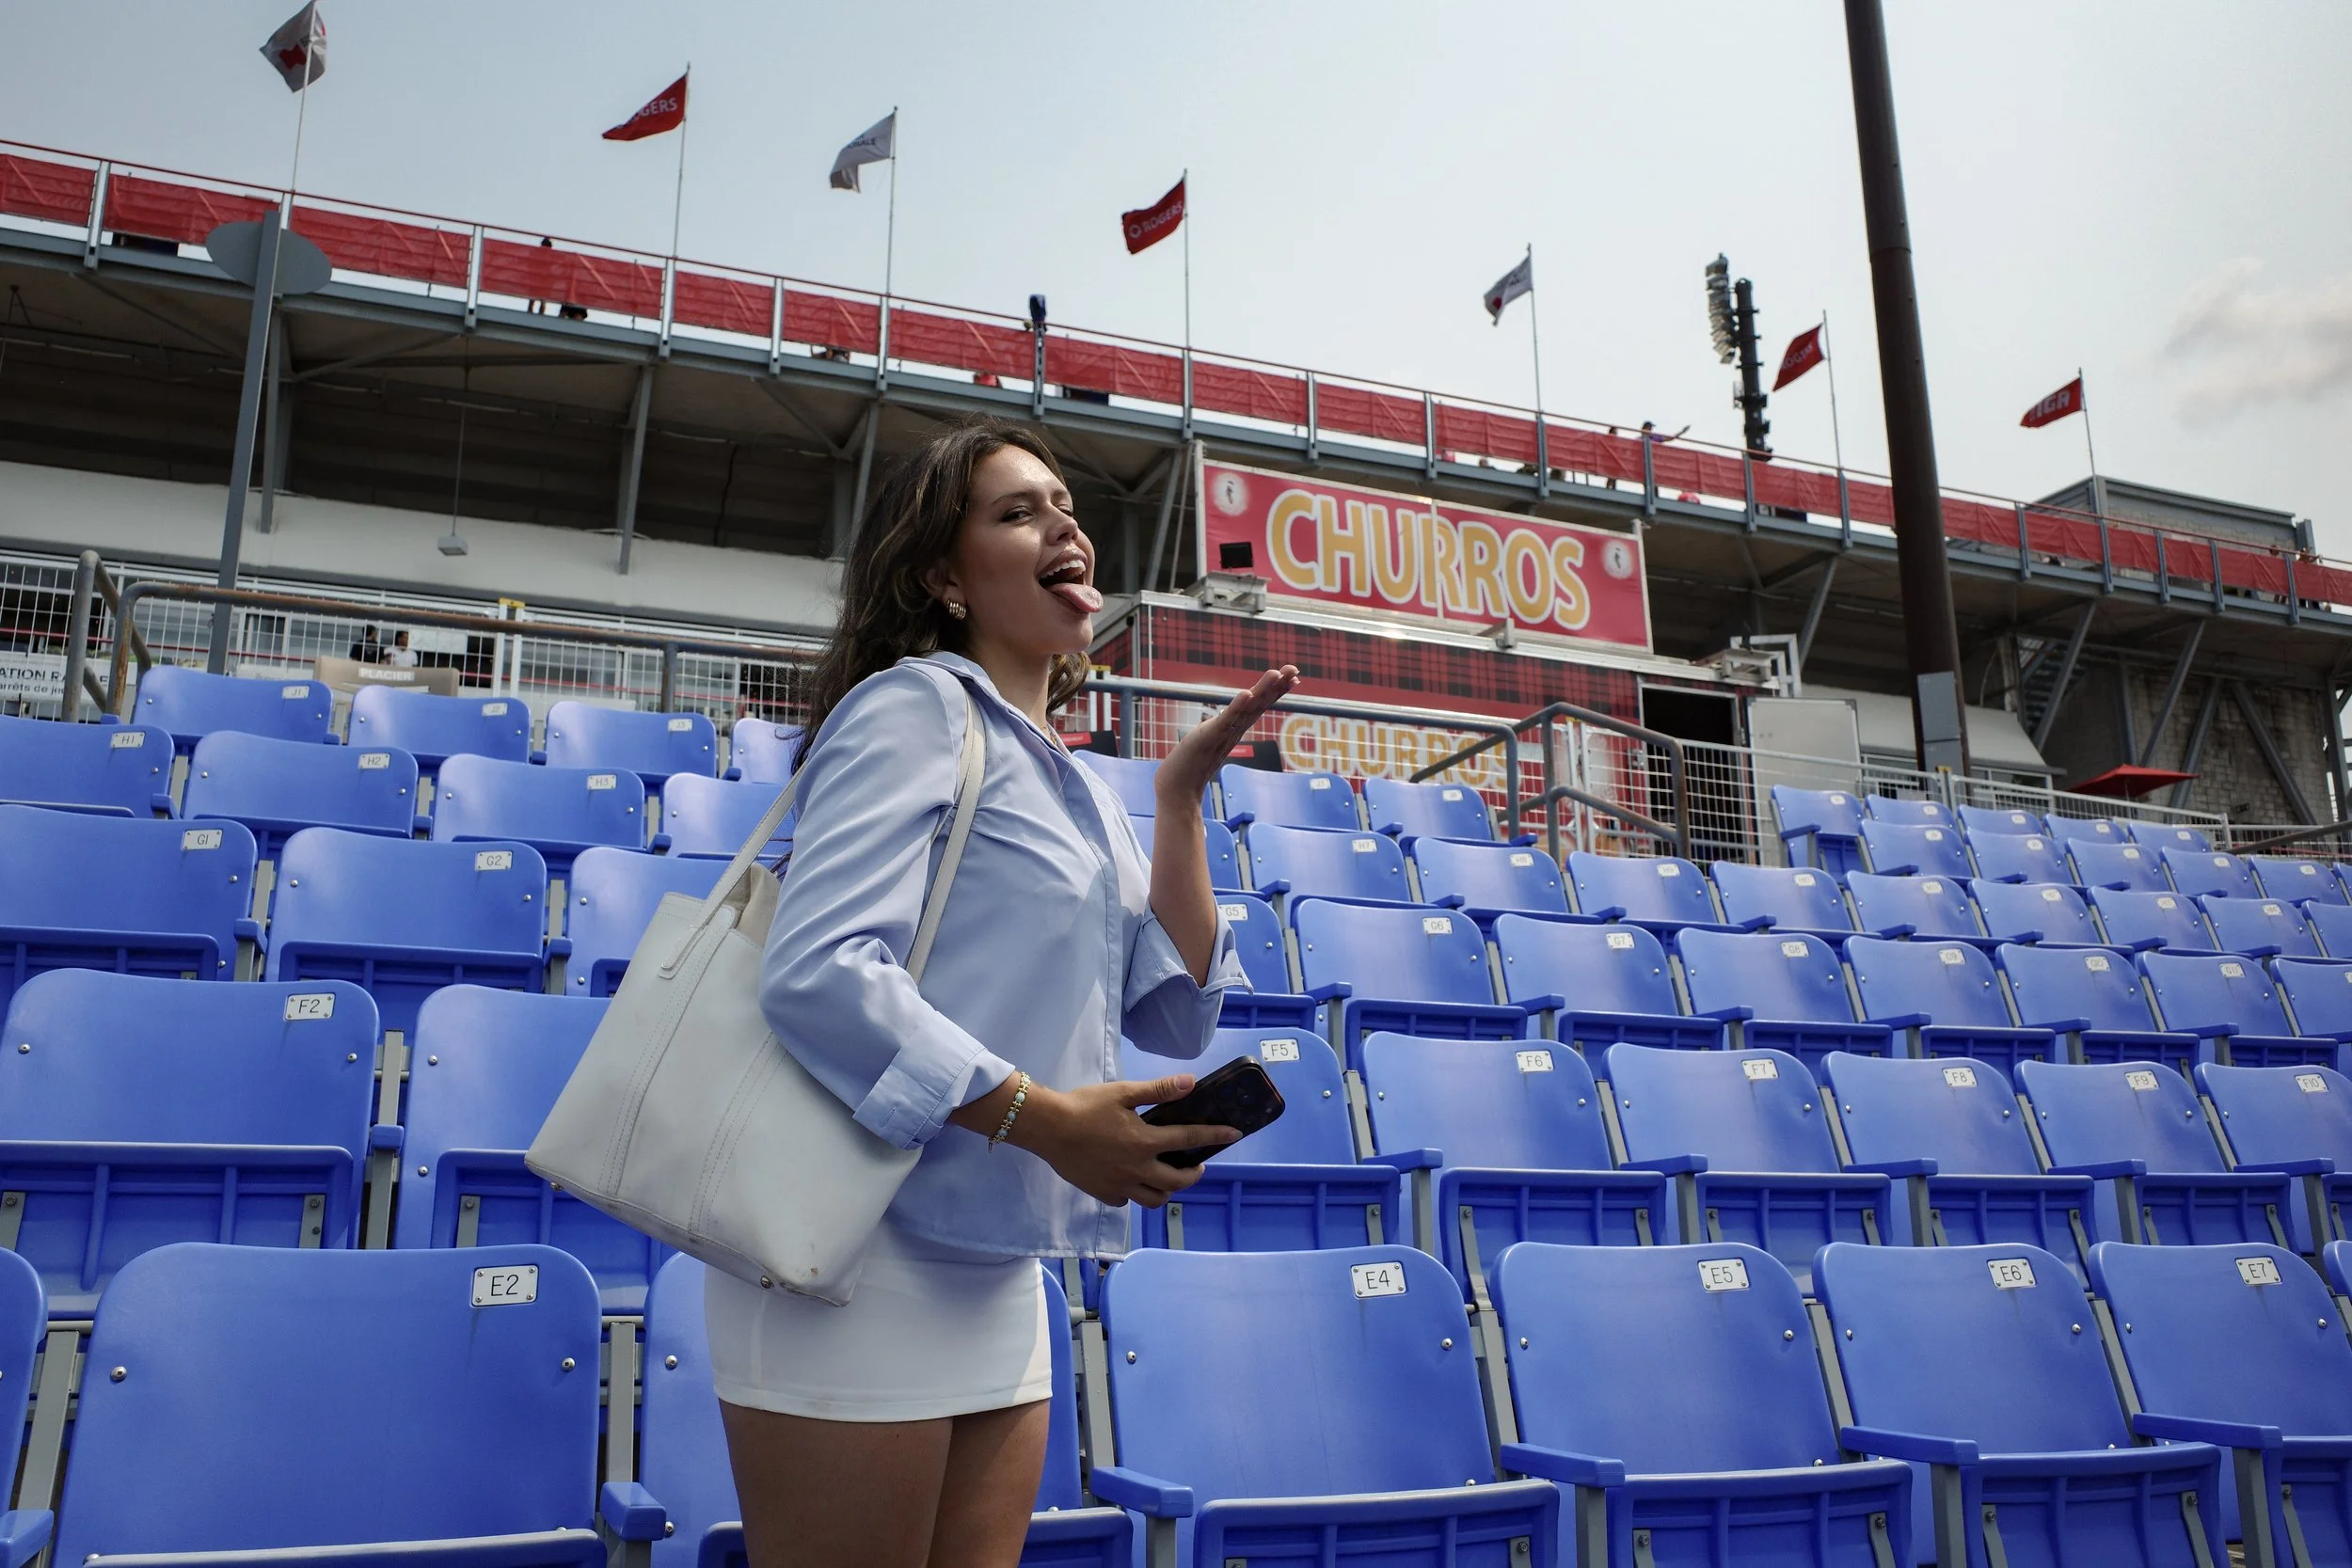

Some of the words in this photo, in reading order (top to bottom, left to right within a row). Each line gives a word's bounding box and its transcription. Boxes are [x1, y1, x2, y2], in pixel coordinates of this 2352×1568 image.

[1142, 201, 1184, 231] ROGERS
[1266, 488, 1590, 630] CHURROS
[359, 668, 412, 681] PLACIER
[34, 684, 48, 692] de
[121, 736, 135, 745] H1
[367, 756, 381, 766] H2
[596, 779, 610, 787] H3
[197, 834, 209, 846] G1
[486, 855, 502, 866] G2
[1225, 907, 1239, 917] G5
[1430, 921, 1444, 931] G6
[1613, 936, 1626, 945] G7
[1788, 944, 1801, 954] G8
[1946, 952, 1957, 961] G9
[298, 999, 320, 1014] F2
[1270, 1044, 1288, 1057] F5
[1526, 1055, 1543, 1068] F6
[1752, 1063, 1766, 1075] F7
[1951, 1071, 1967, 1084] F8
[2134, 1075, 2149, 1086] F9
[2302, 1078, 2320, 1088] F10
[1710, 1266, 1733, 1284] E5
[2000, 1265, 2022, 1282] E6
[2248, 1262, 2266, 1278] E7
[490, 1274, 519, 1297] E2
[1365, 1270, 1390, 1289] E4
